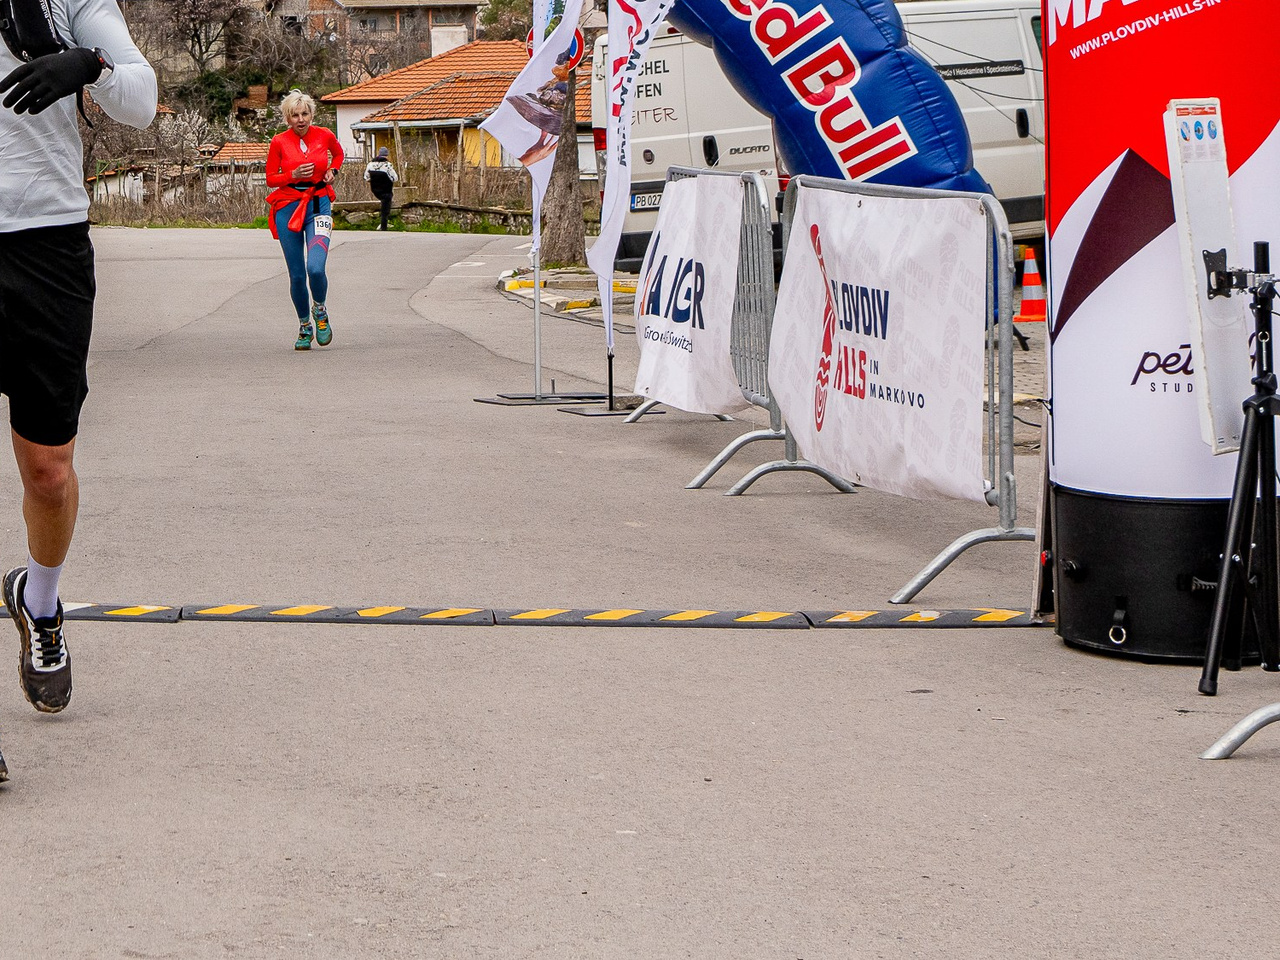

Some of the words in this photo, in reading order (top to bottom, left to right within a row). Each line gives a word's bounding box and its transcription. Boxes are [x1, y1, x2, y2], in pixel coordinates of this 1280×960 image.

[634, 83, 662, 98] FEN
[784, 39, 915, 182] Bull
[730, 145, 770, 155] DUCATO
[636, 195, 646, 207] PB
[647, 194, 661, 207] 027
[870, 359, 878, 375] IN
[1150, 382, 1193, 392] STUD
[870, 383, 924, 408] MARKOVO
